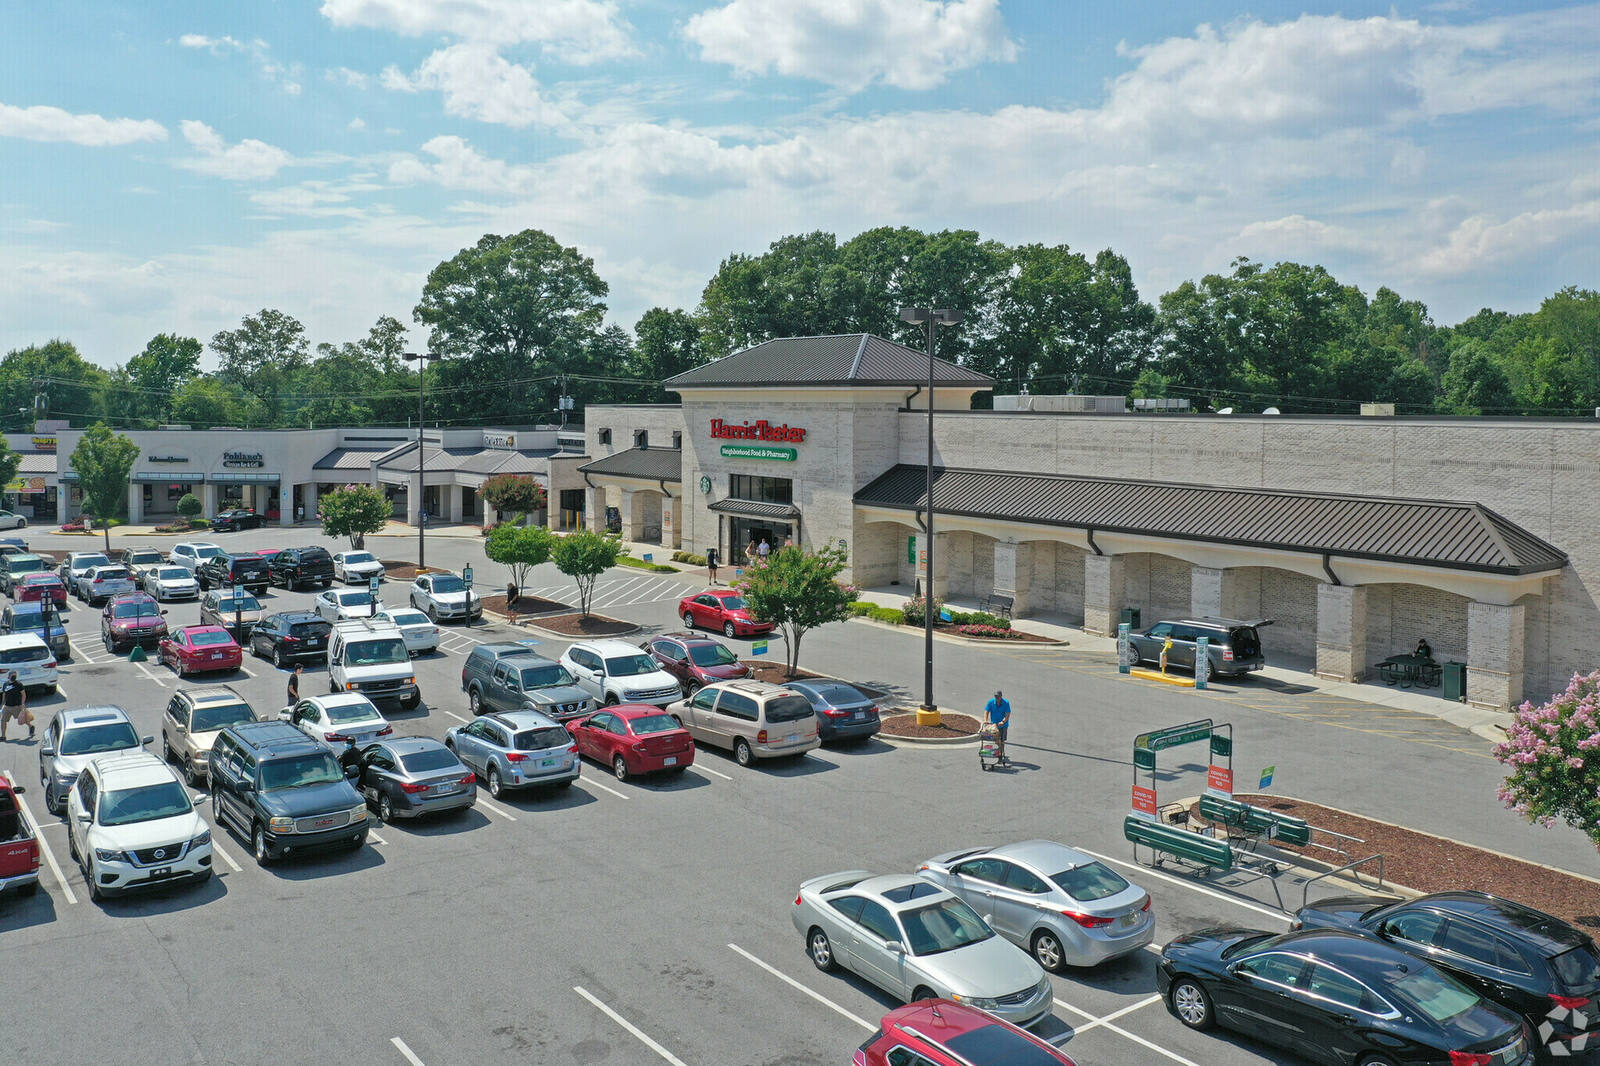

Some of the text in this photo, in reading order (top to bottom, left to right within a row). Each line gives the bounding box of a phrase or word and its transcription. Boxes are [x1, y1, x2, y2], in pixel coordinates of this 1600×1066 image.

[710, 418, 806, 442] Harris Teeter
[722, 447, 751, 456] Neighborhood
[751, 449, 761, 457] Food
[767, 450, 790, 459] Pharmacy
